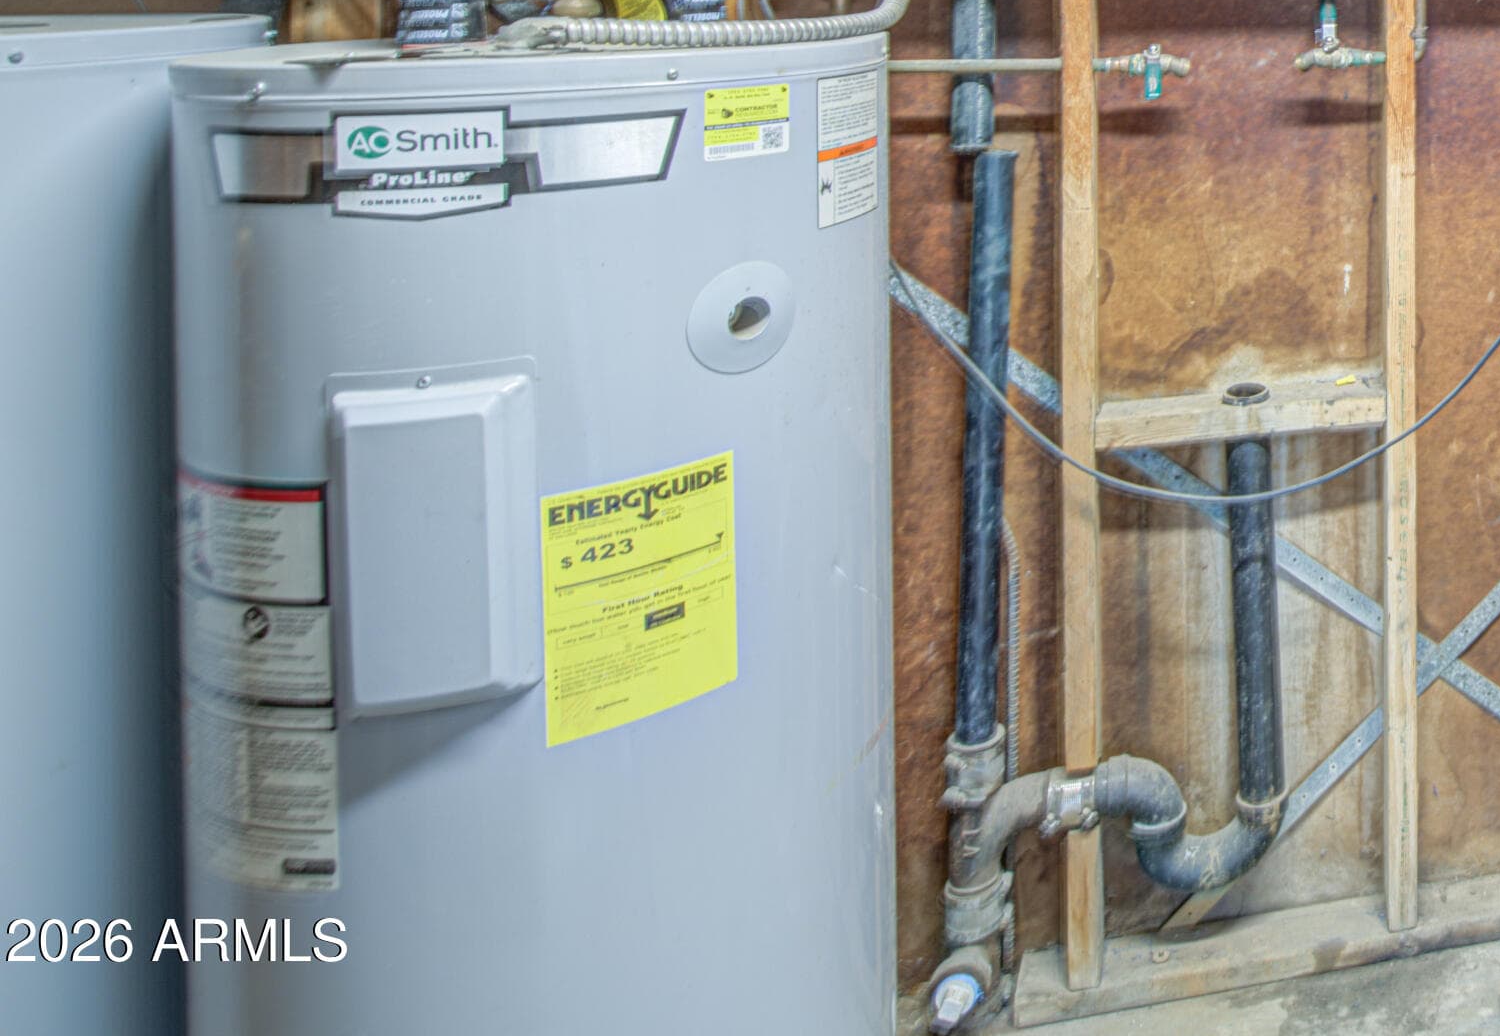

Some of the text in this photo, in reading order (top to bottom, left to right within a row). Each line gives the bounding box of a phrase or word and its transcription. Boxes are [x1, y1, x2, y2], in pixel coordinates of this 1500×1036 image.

[371, 169, 468, 188] ProLine
[360, 193, 483, 207] COMMERCIAL GRADE
[576, 513, 682, 546] Estimated Yearly Energy Cost
[560, 537, 634, 570] $ 423
[602, 584, 684, 614] First Hour Rating
